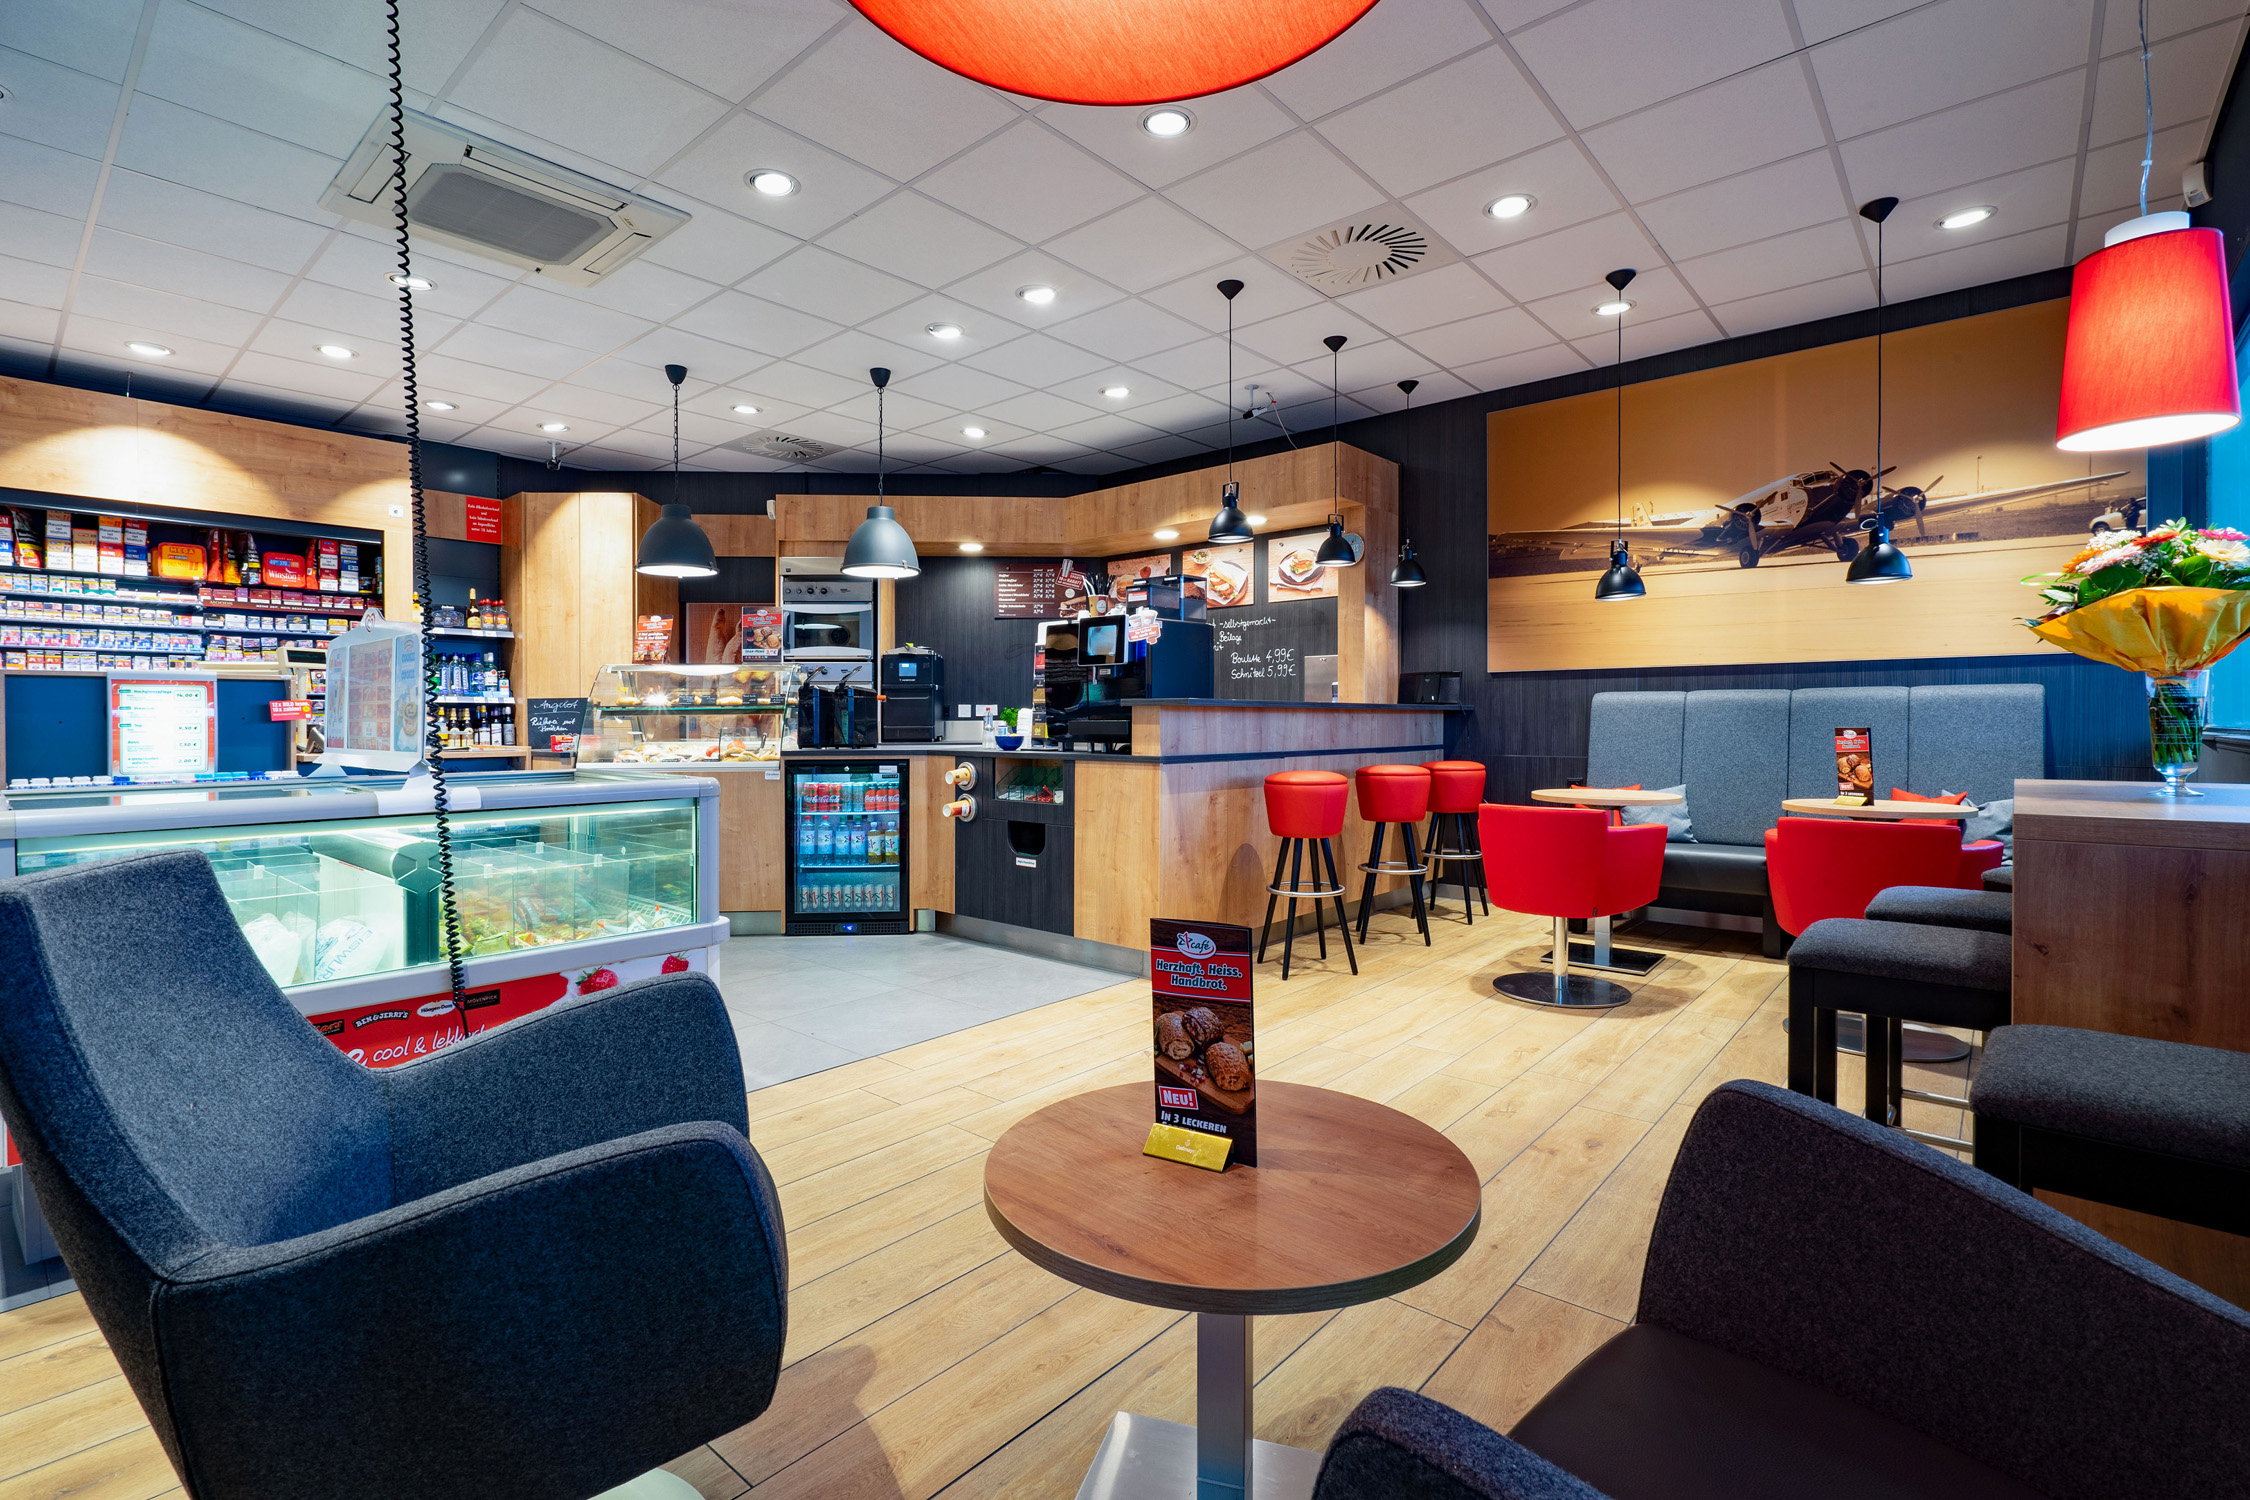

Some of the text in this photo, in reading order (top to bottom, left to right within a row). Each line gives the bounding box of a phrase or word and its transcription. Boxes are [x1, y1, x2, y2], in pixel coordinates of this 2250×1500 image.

[268, 569, 297, 580] Winston
[1220, 631, 1242, 645] Beilage
[1231, 648, 1294, 664] Boulette 4,99€
[1231, 664, 1296, 679] Schnitzel 5,99€
[1190, 940, 1210, 953] café
[1156, 959, 1243, 978] Herzhaft. Heiss.
[1171, 974, 1227, 990] Handbrot.
[373, 1035, 410, 1062] cool
[414, 1037, 427, 1053] &
[1163, 1090, 1194, 1107] NEU!
[1173, 1113, 1179, 1123] 3
[1182, 1116, 1227, 1134] LECKEREN
